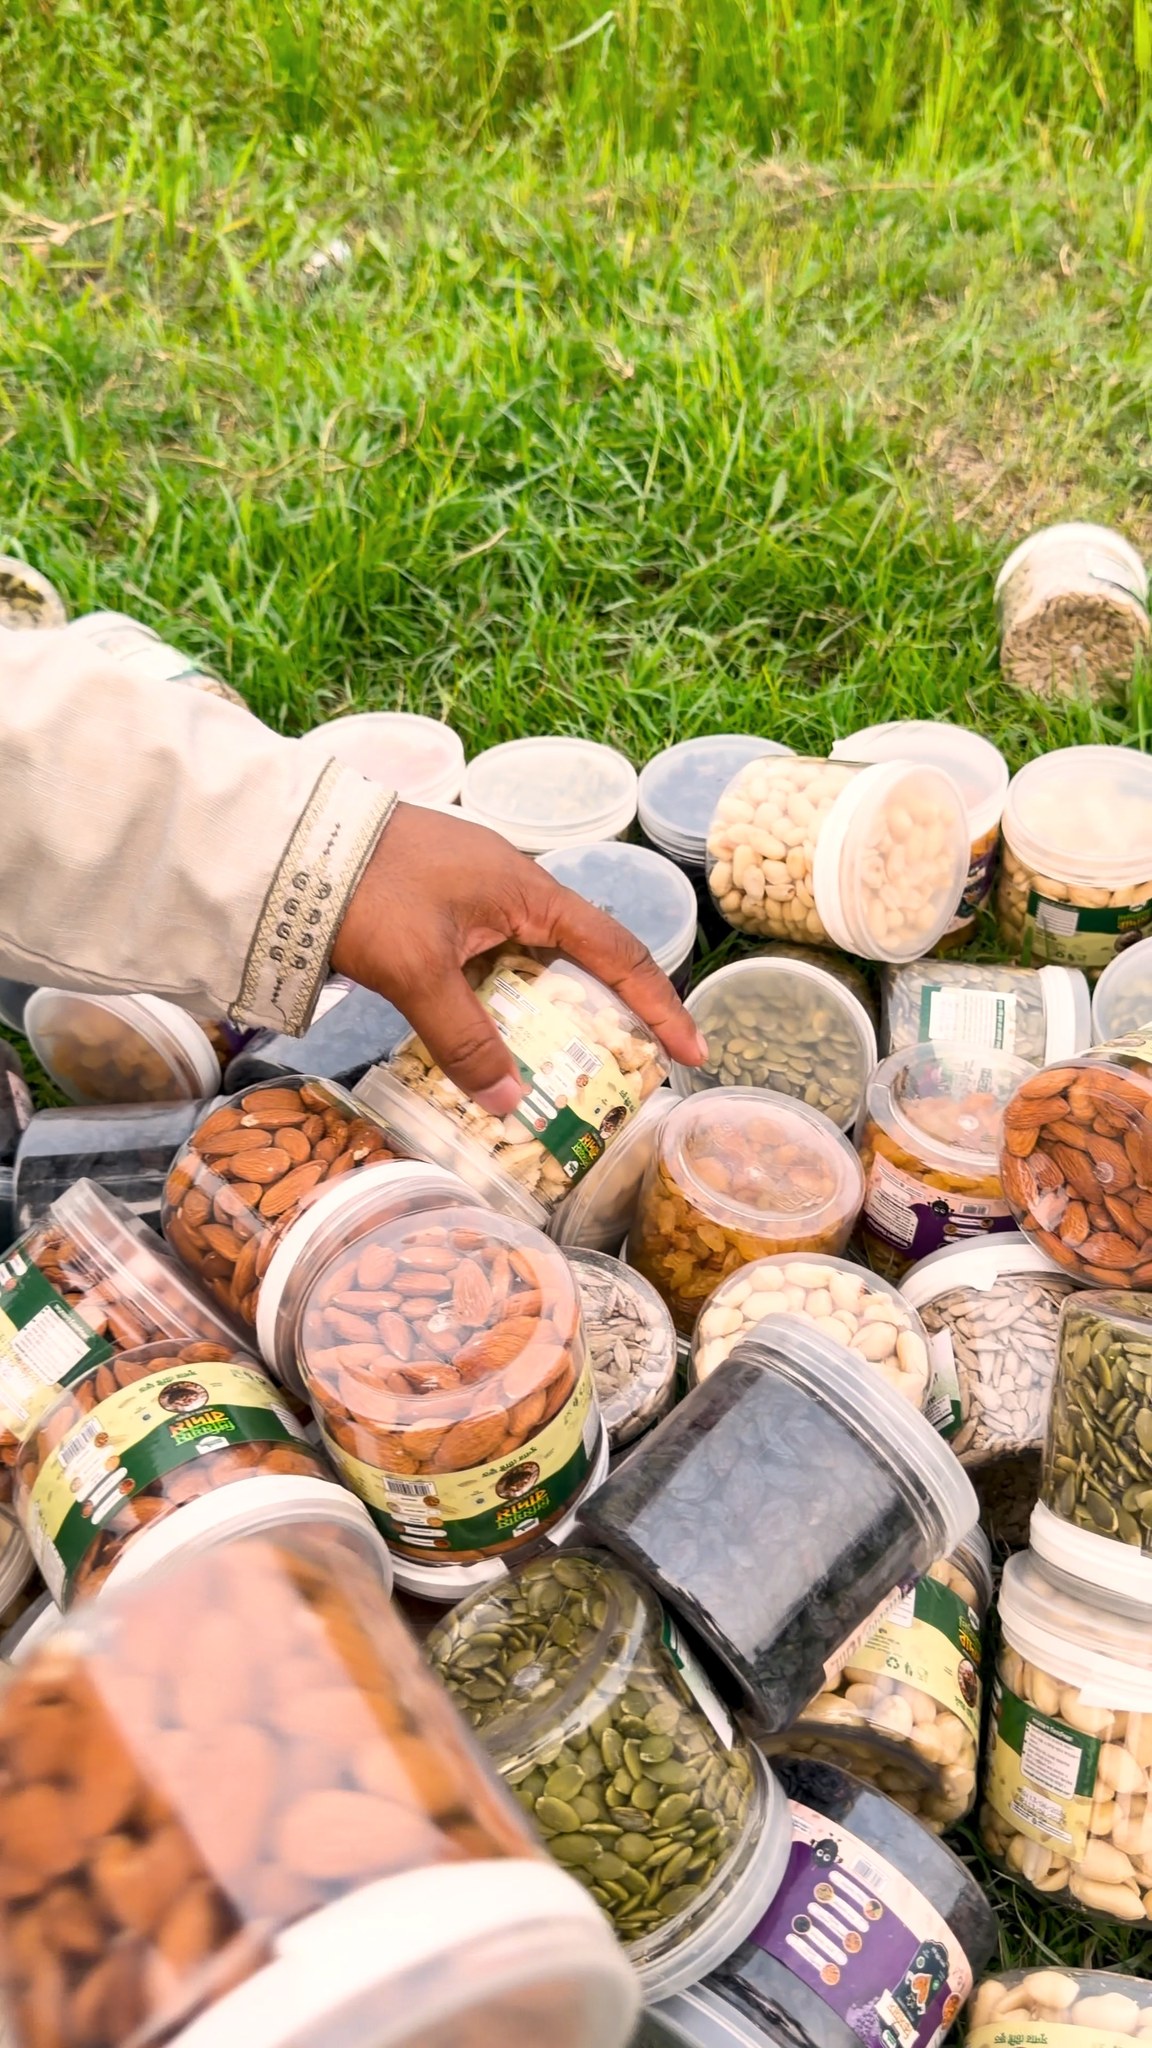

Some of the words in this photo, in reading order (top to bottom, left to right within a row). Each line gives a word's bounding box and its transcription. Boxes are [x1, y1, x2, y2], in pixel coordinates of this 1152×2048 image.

[168, 1410, 230, 1439] বাদাম
[174, 1420, 236, 1447] প্রিমিয়াম
[496, 1489, 548, 1521] বাদাম
[1026, 2032, 1048, 2044] সুপার
